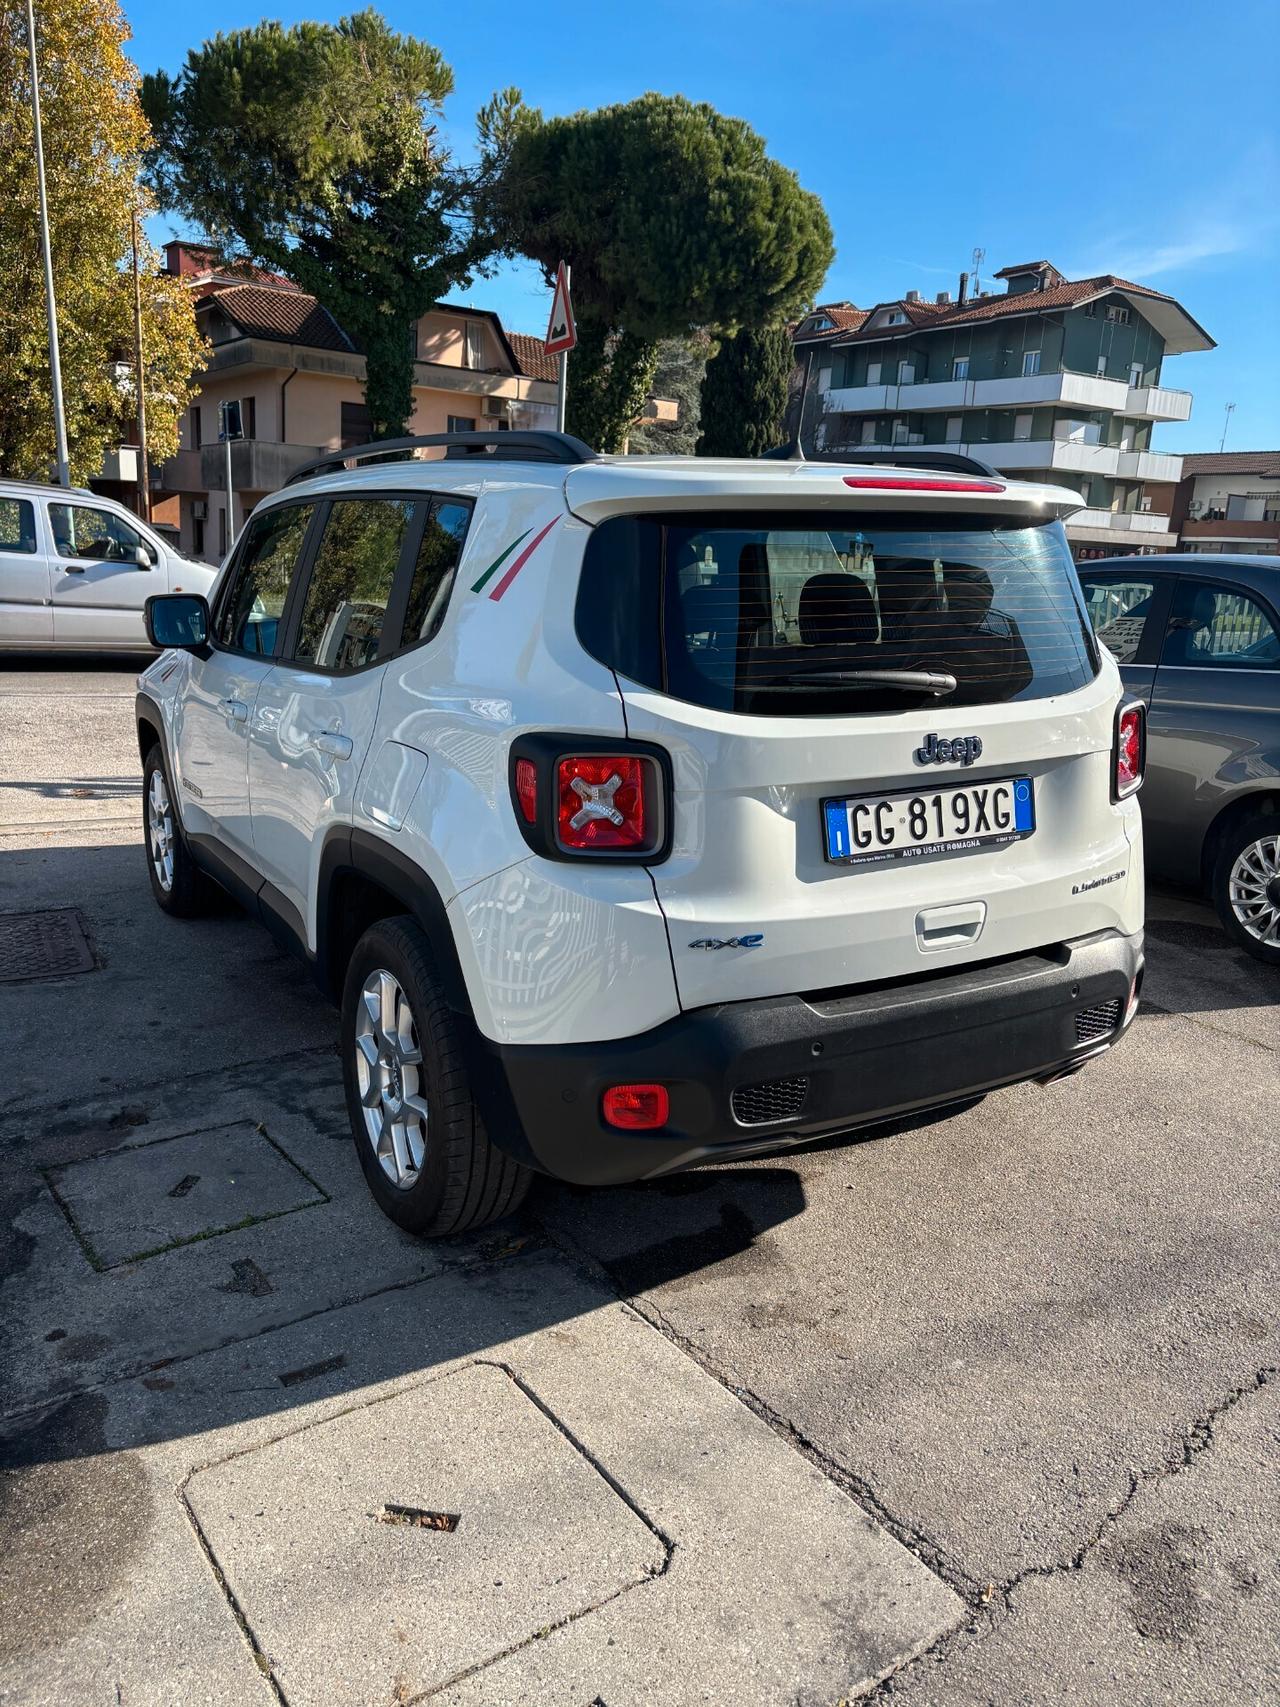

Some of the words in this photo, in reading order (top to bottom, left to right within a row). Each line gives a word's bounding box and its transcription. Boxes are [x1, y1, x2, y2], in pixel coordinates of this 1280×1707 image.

[917, 733, 982, 767] Jeep
[852, 801, 895, 848] GG
[908, 787, 1010, 841] 819XG
[902, 847, 922, 858] AUTO
[923, 843, 946, 855] USATE
[946, 839, 981, 851] ROMAGNA
